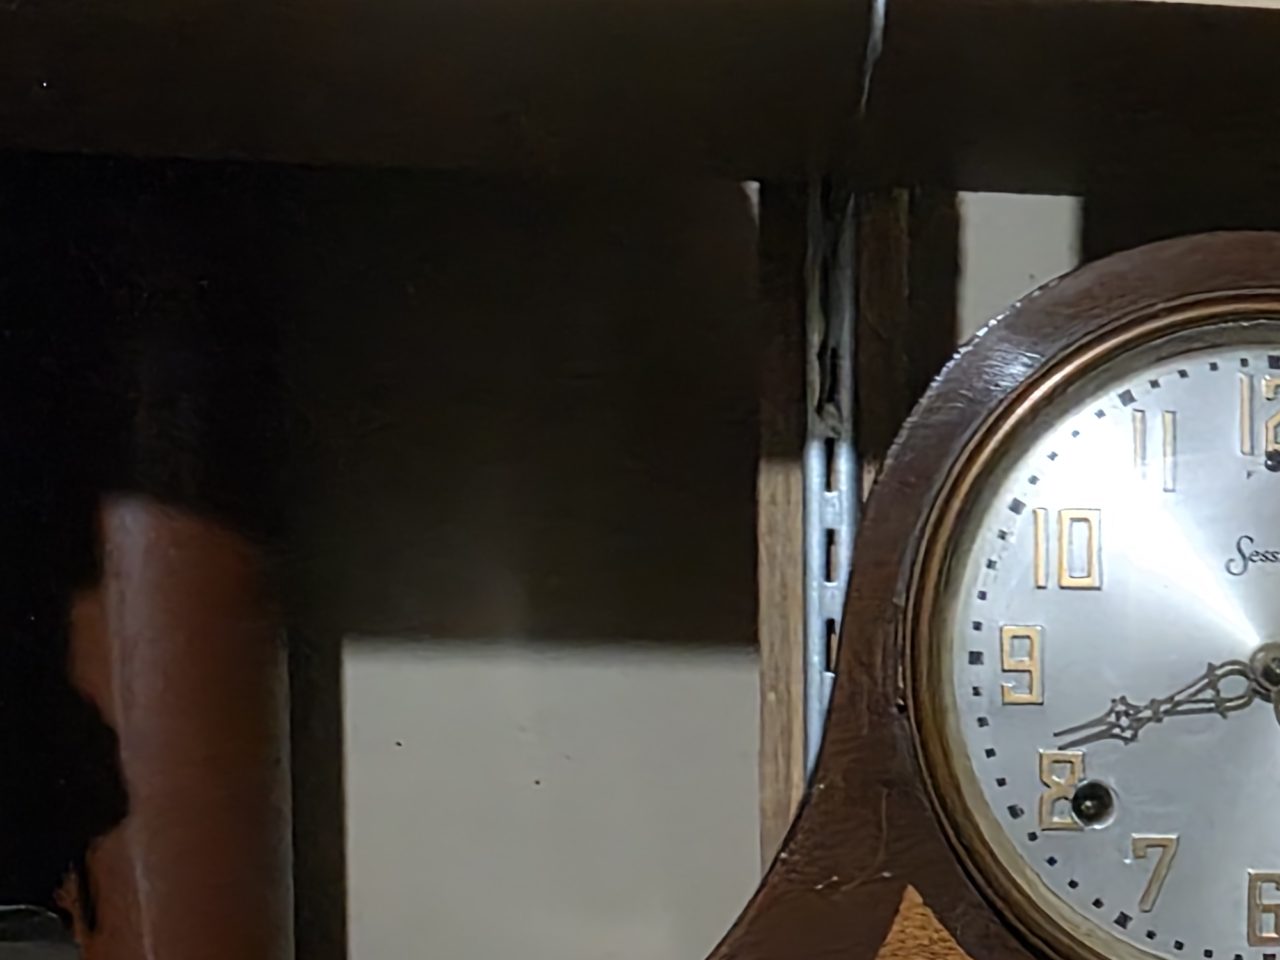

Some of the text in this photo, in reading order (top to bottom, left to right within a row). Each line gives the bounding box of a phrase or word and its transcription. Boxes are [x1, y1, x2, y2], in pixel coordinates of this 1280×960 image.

[1131, 408, 1177, 493] 11
[1033, 507, 1101, 590] 10
[1001, 624, 1044, 705] 9
[1038, 749, 1084, 831] 8
[1130, 833, 1180, 912] 7
